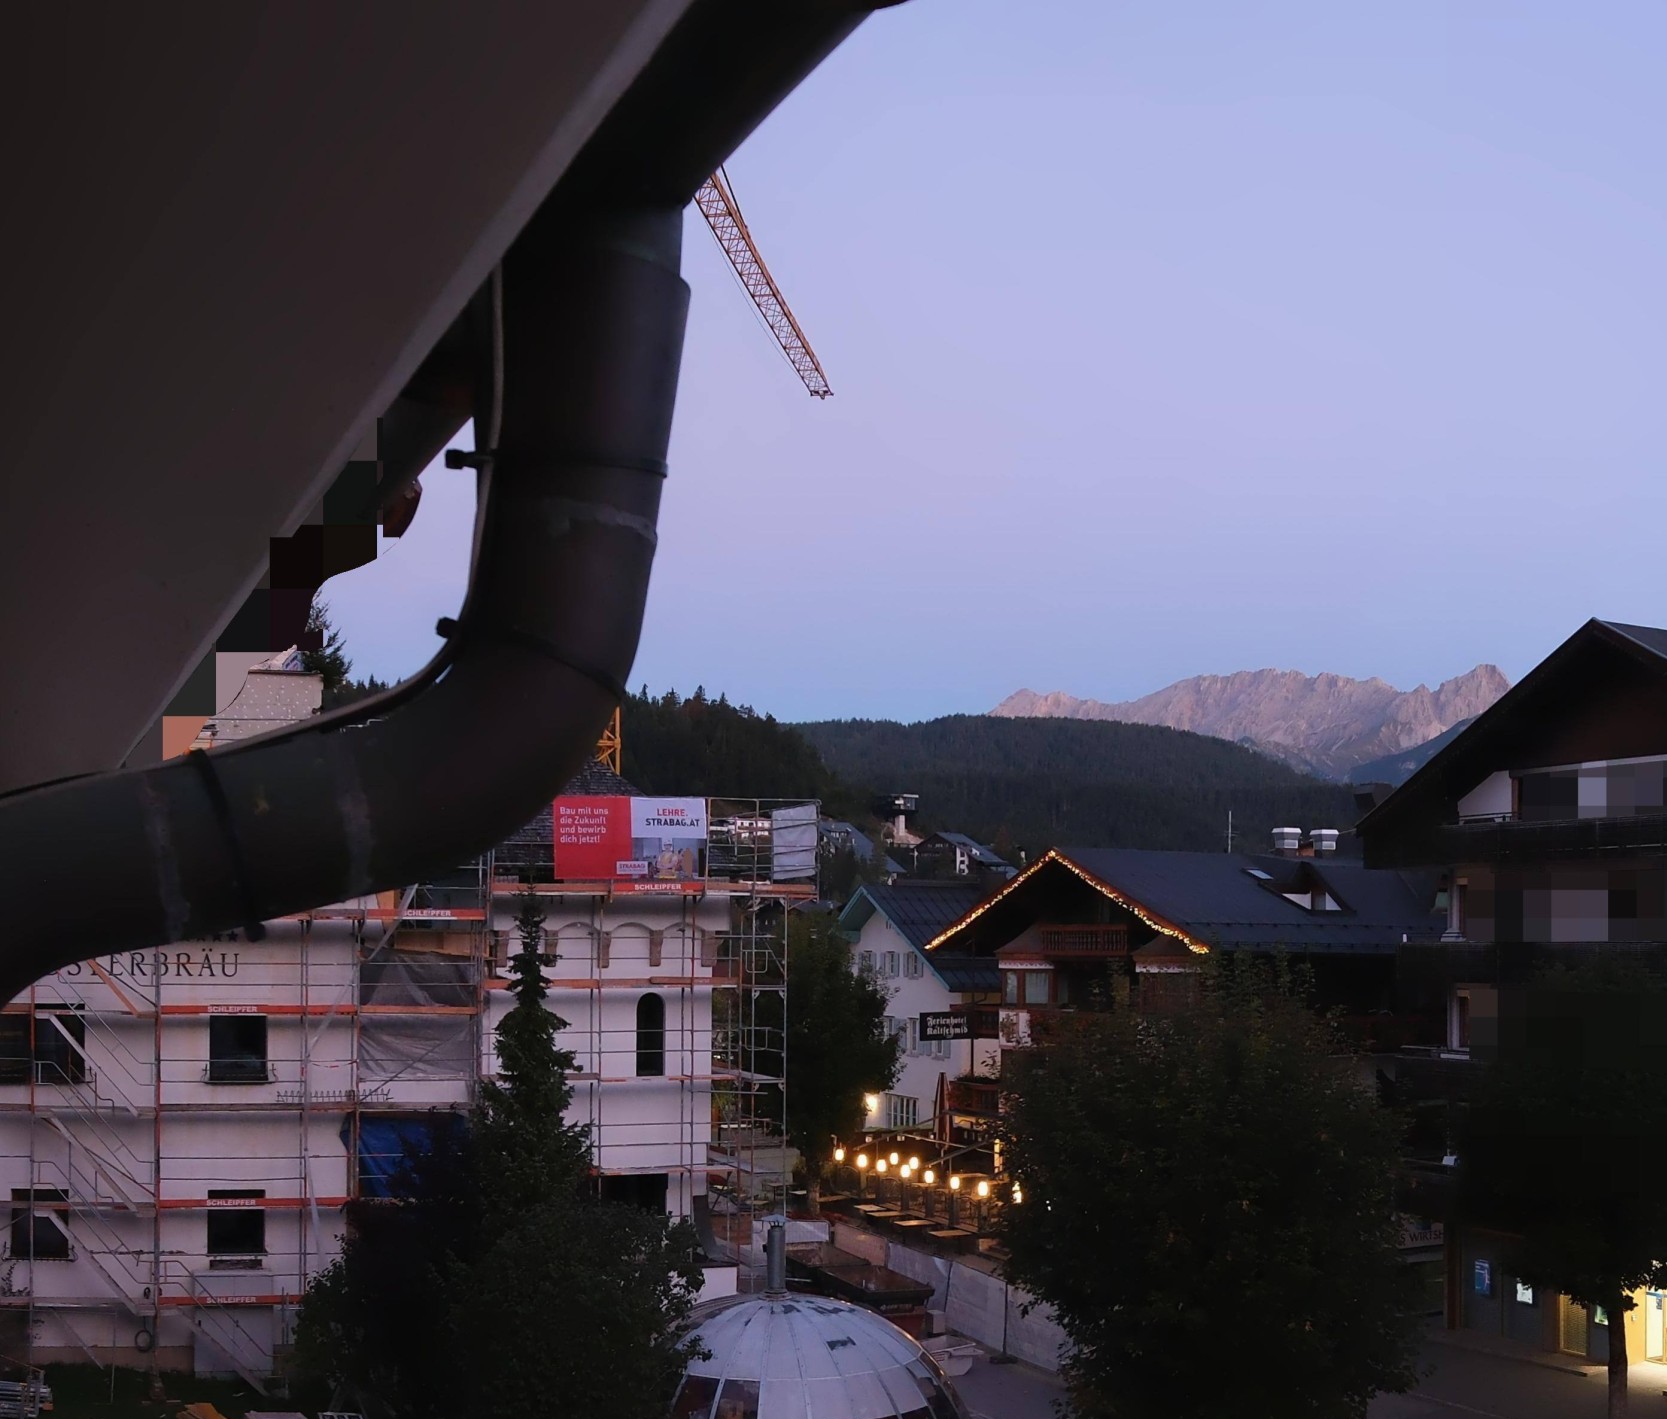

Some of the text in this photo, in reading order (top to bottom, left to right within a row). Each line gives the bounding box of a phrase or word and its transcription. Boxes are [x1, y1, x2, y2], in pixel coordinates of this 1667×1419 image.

[559, 806, 609, 815] Bau mit uns
[656, 808, 689, 817] LEHRE.
[560, 816, 607, 824] die Zukunft
[645, 818, 700, 828] STRABAG.AT
[560, 825, 607, 834] und bewirb
[560, 835, 601, 845] dich jetzt!
[634, 883, 682, 891] SCHLEIPFER
[207, 1005, 258, 1013] SCHLEIPFER
